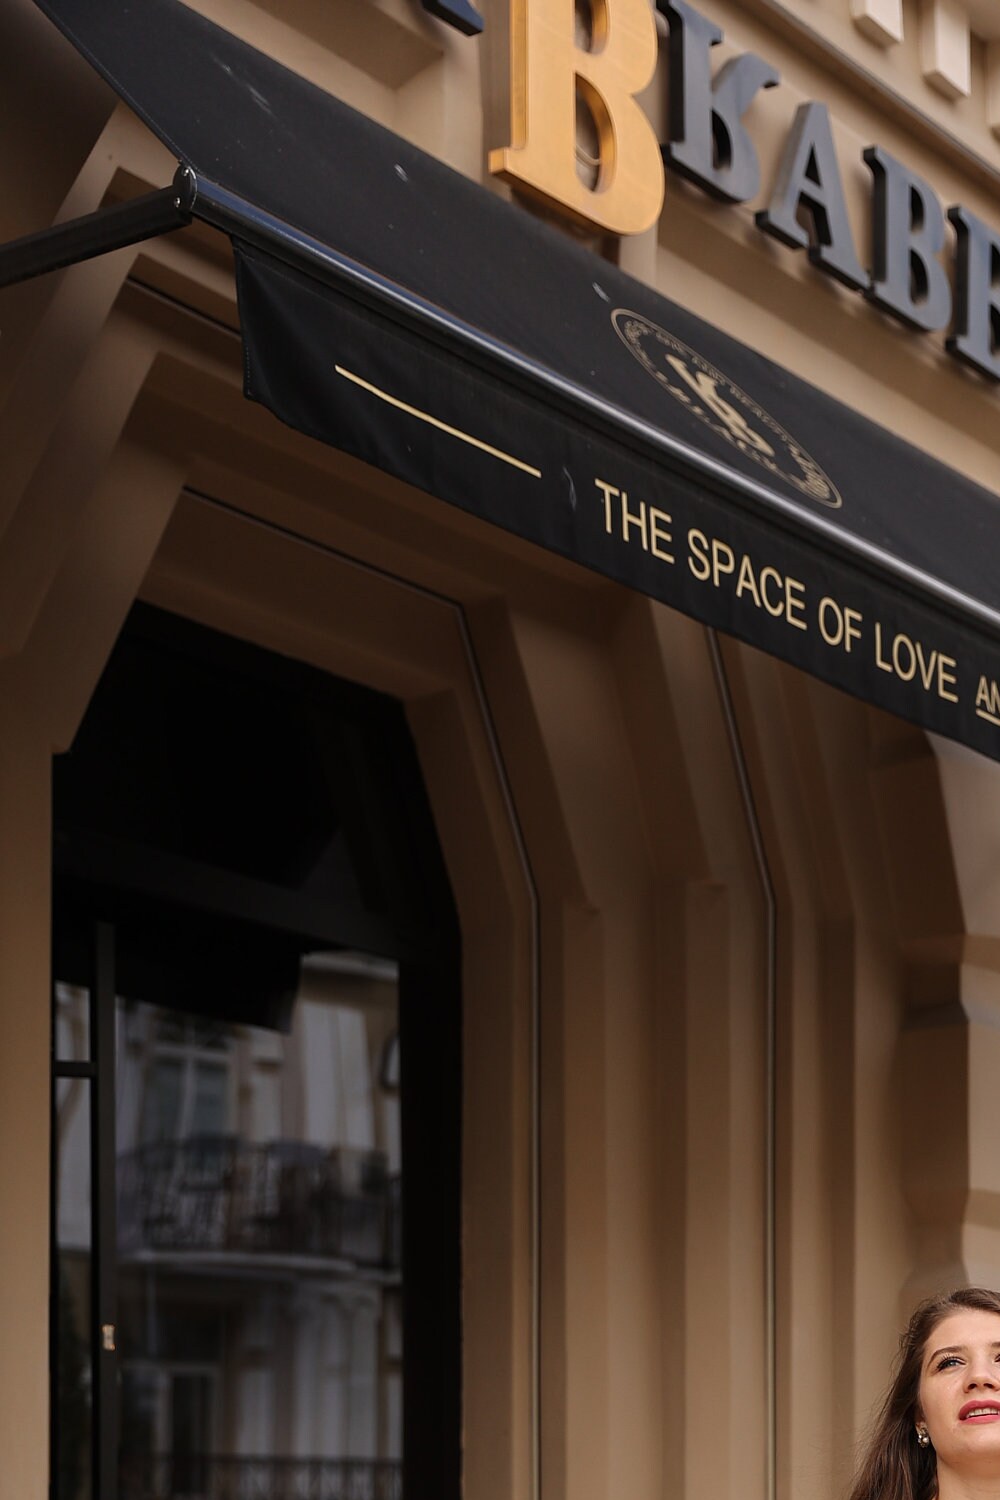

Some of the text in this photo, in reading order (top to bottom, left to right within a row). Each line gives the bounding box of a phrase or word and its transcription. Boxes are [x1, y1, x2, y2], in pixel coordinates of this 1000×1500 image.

[594, 477, 676, 565] THE
[686, 528, 808, 631] SPACE
[817, 596, 864, 653] OF
[874, 621, 959, 704] LOVE
